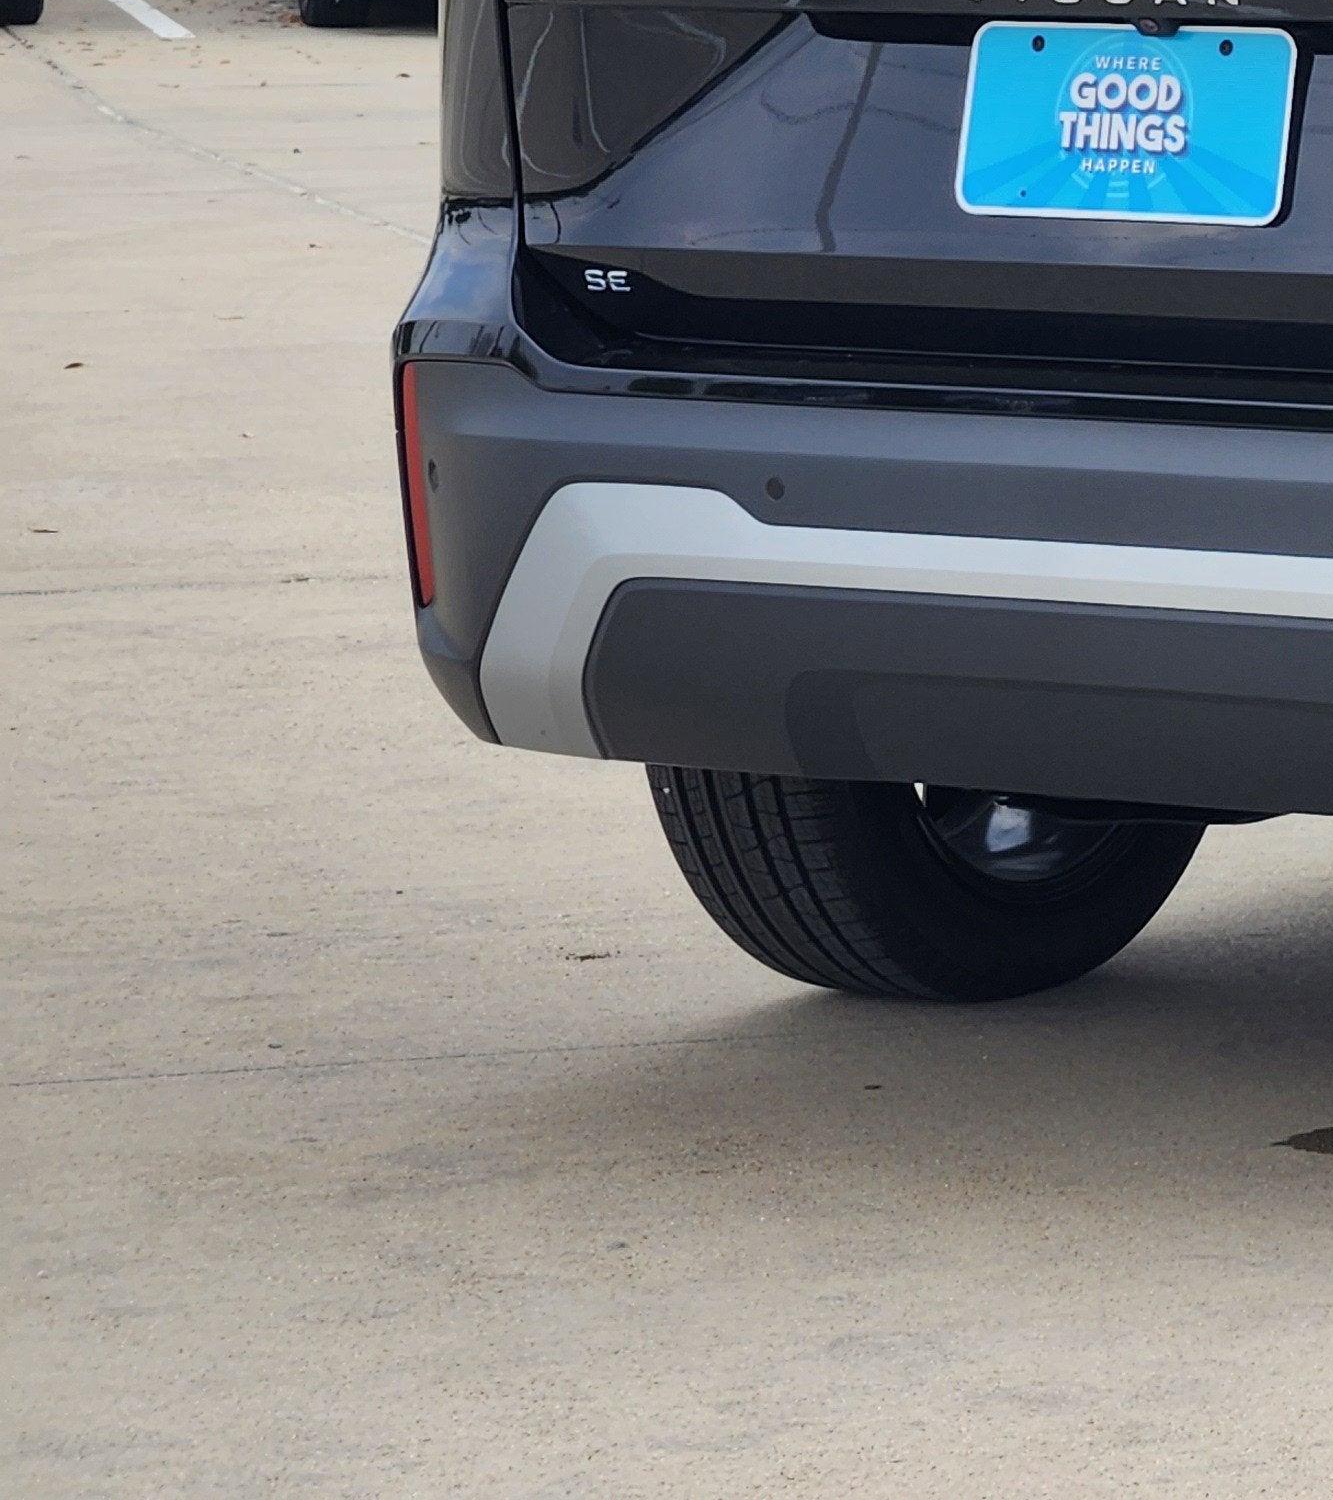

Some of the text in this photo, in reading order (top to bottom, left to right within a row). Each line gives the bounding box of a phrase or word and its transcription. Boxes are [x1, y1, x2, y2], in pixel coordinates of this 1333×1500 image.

[1095, 56, 1162, 71] WHERE
[1069, 72, 1181, 113] GOOD
[1058, 112, 1187, 155] THINGS
[1081, 157, 1156, 174] HAPPEN
[584, 269, 632, 293] SE
